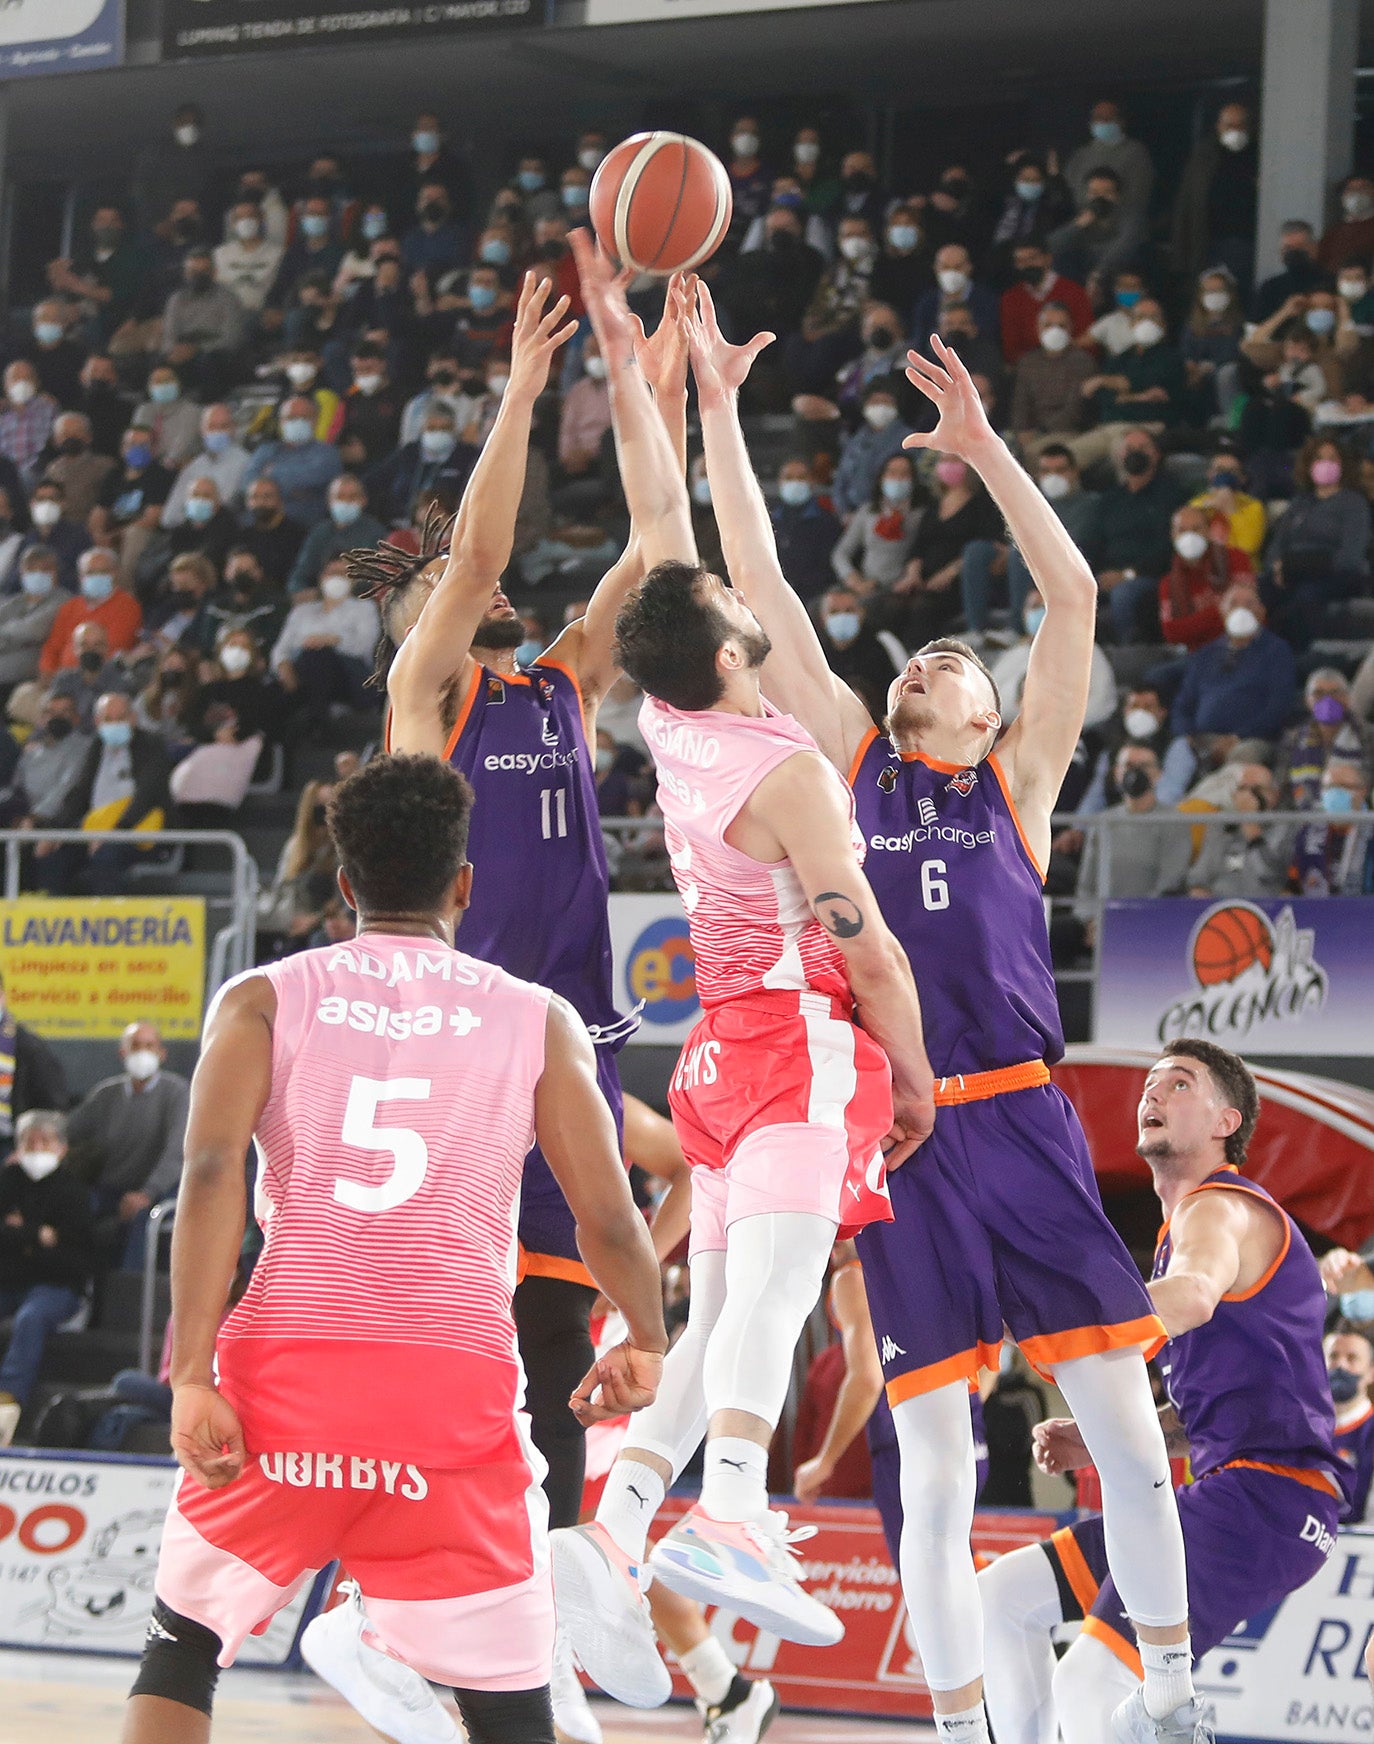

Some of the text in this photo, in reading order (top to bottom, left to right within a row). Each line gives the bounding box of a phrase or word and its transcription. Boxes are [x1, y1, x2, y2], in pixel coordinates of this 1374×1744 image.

[540, 787, 567, 840] 11
[870, 825, 996, 853] easycharger
[920, 859, 950, 911] 6
[4, 905, 192, 946] LAVANDERÍA
[98, 960, 118, 974] en
[126, 960, 168, 974] seco
[327, 949, 481, 988] ADAMS
[10, 984, 190, 1006] Servicio a domicilio
[316, 996, 444, 1041] asisa
[333, 1074, 432, 1213] 5
